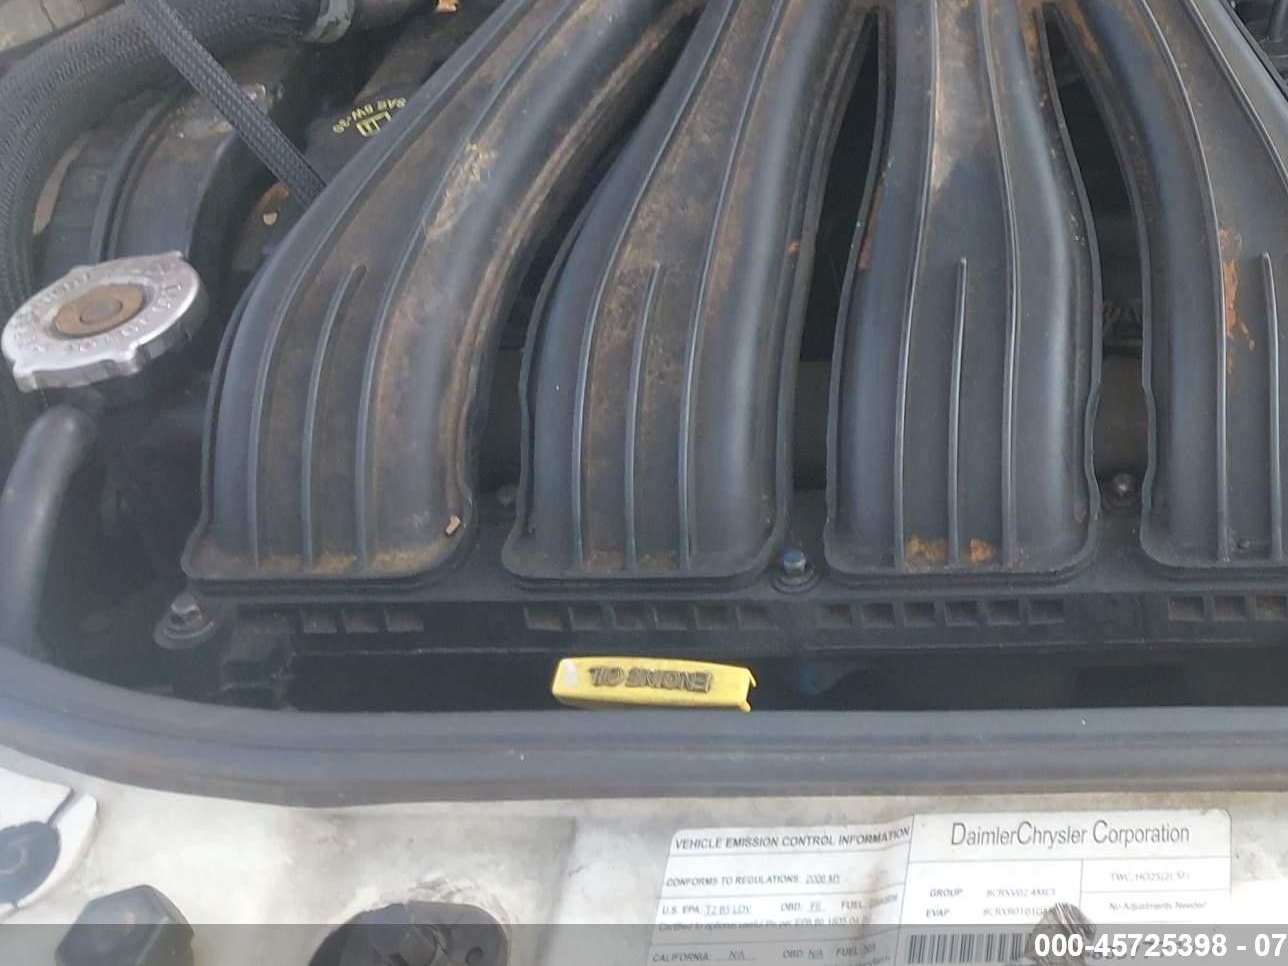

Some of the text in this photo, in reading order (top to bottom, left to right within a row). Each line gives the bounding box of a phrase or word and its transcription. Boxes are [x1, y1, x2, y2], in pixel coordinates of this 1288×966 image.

[589, 665, 713, 694] ENGINE OIL
[675, 825, 910, 849] VEHICLE EMISSION CONTROL INFORMATION
[951, 819, 1191, 849] DaimlerChrysler Corporation
[666, 875, 718, 887] CONFORMS
[721, 875, 734, 885] TO
